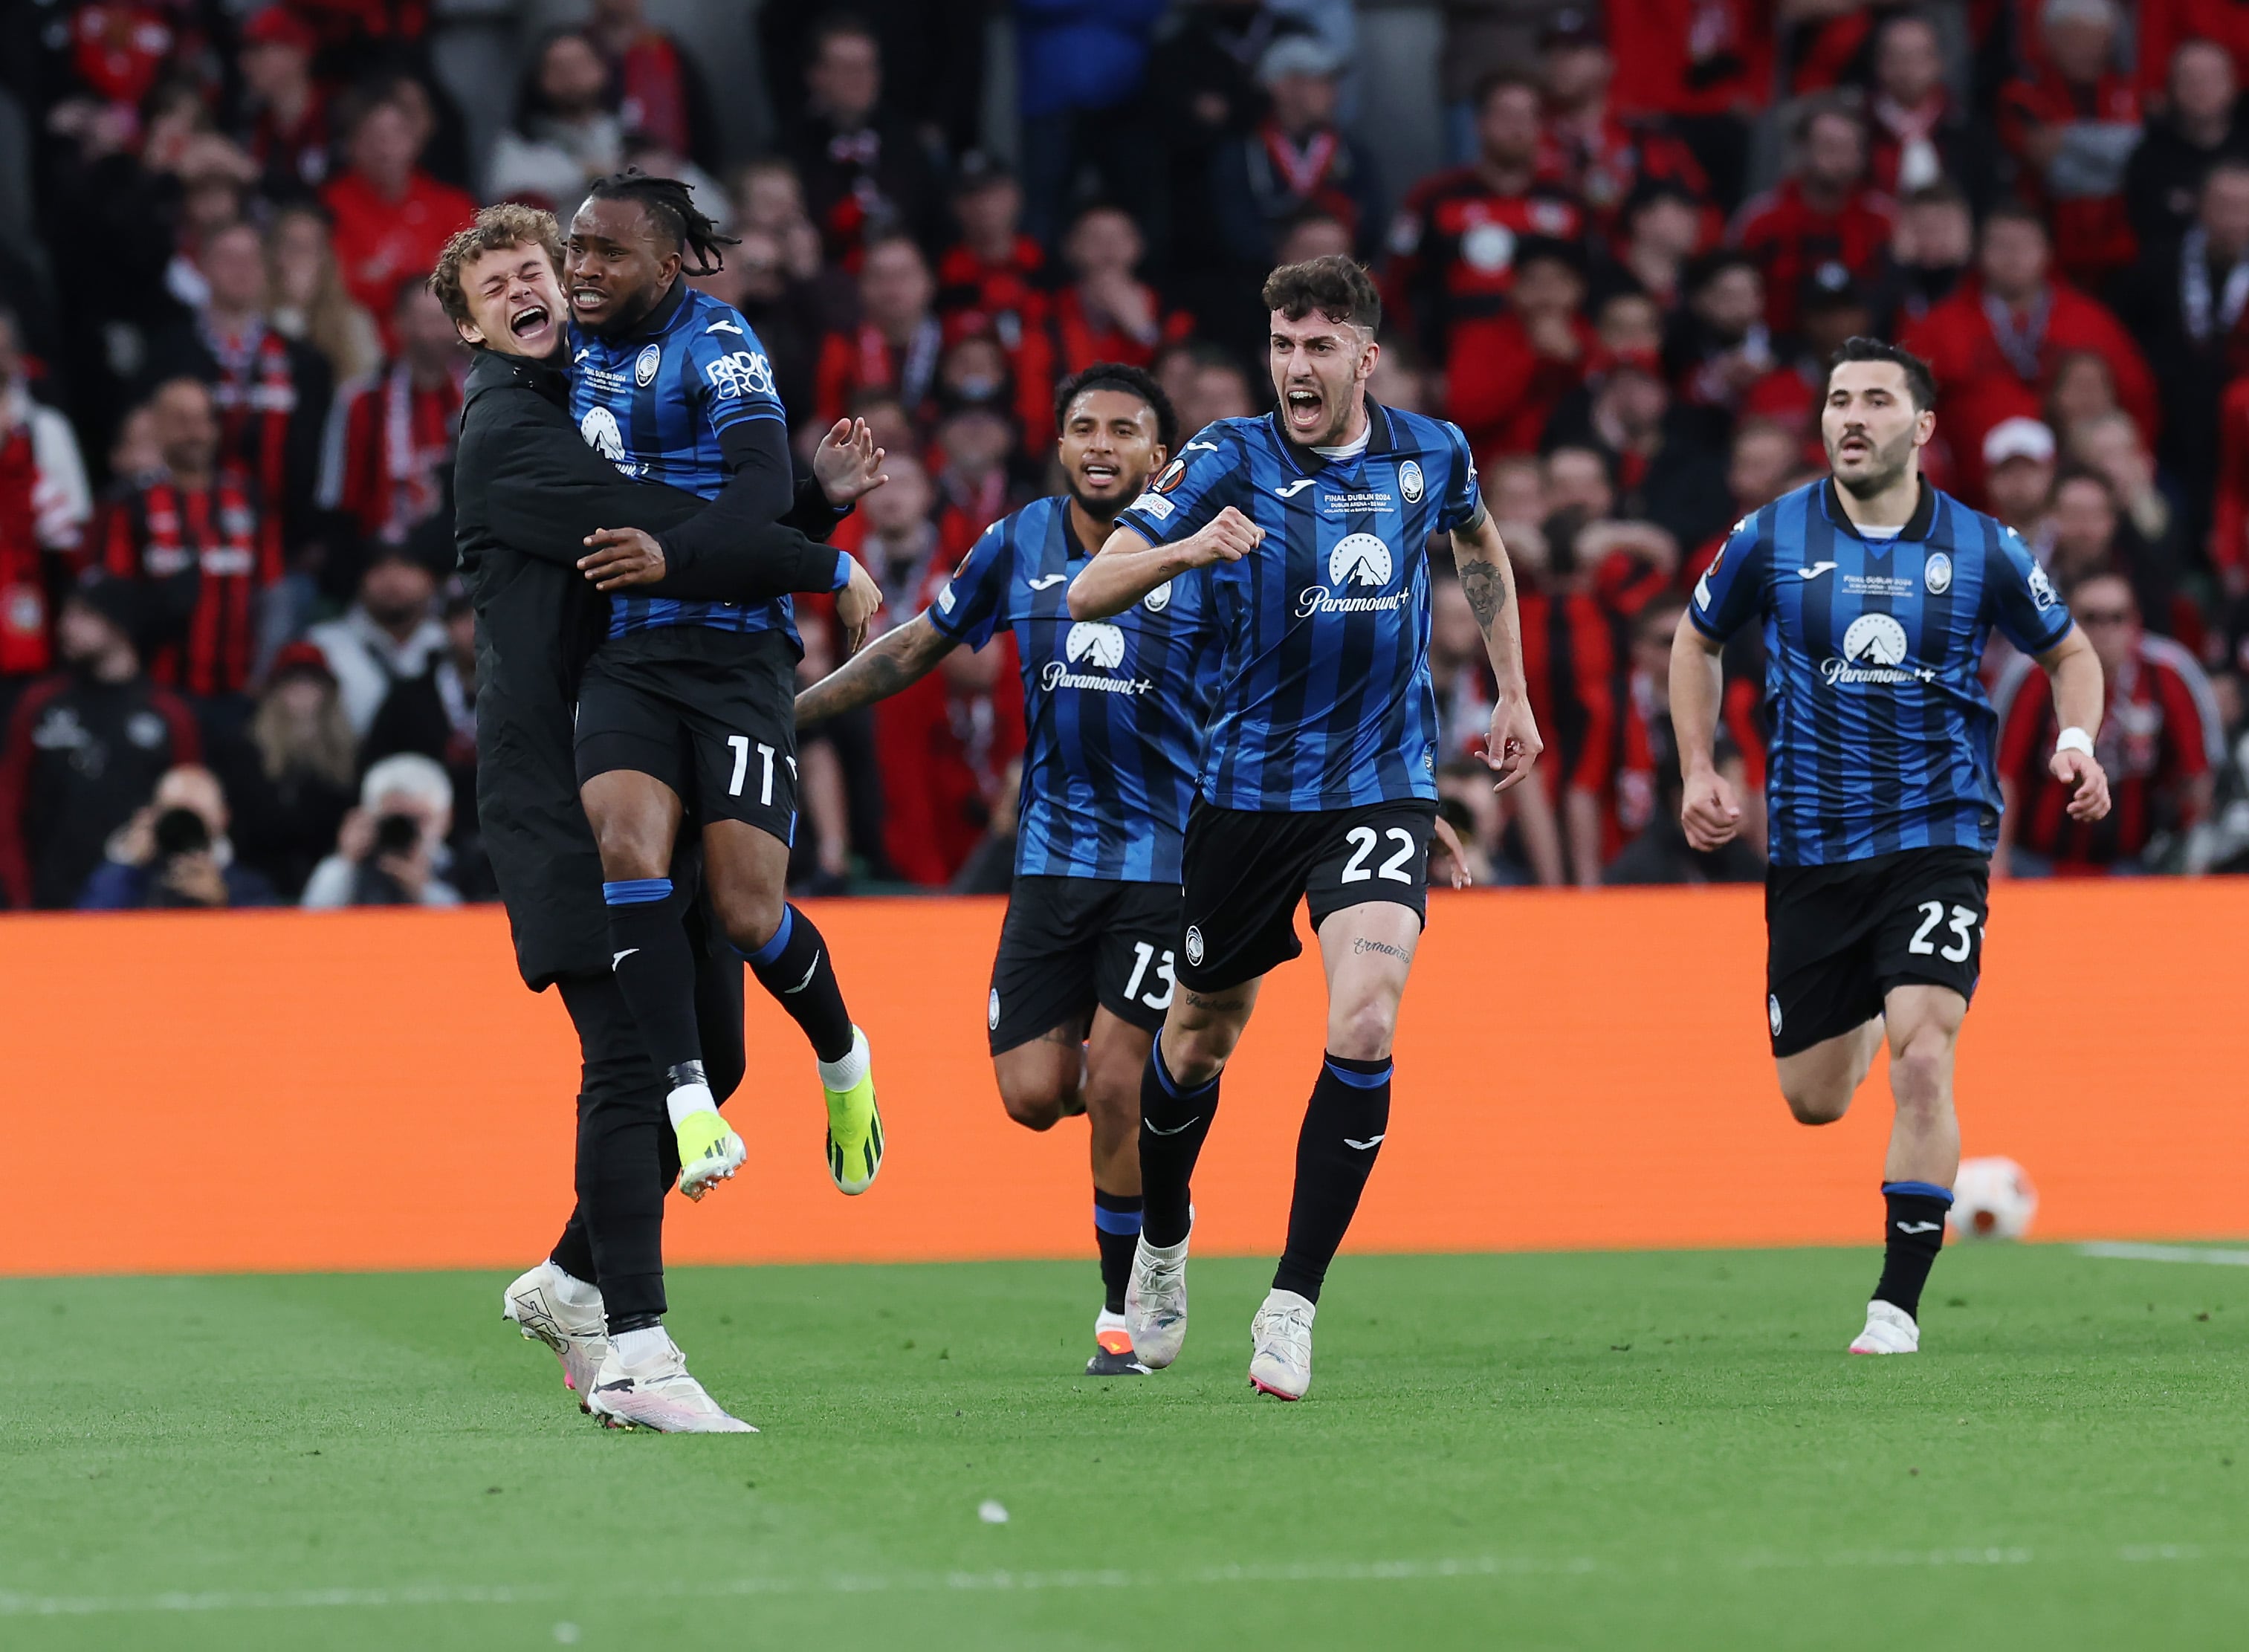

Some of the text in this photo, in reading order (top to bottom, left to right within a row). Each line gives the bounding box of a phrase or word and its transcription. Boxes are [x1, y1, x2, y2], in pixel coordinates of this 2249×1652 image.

[718, 372, 777, 400] GROU
[1295, 585, 1409, 618] Paramount+
[1041, 661, 1153, 695] Paramount+
[728, 735, 774, 806] 11
[1341, 826, 1415, 885] 22
[1908, 900, 1978, 962] 23
[1123, 941, 1177, 1010] 13
